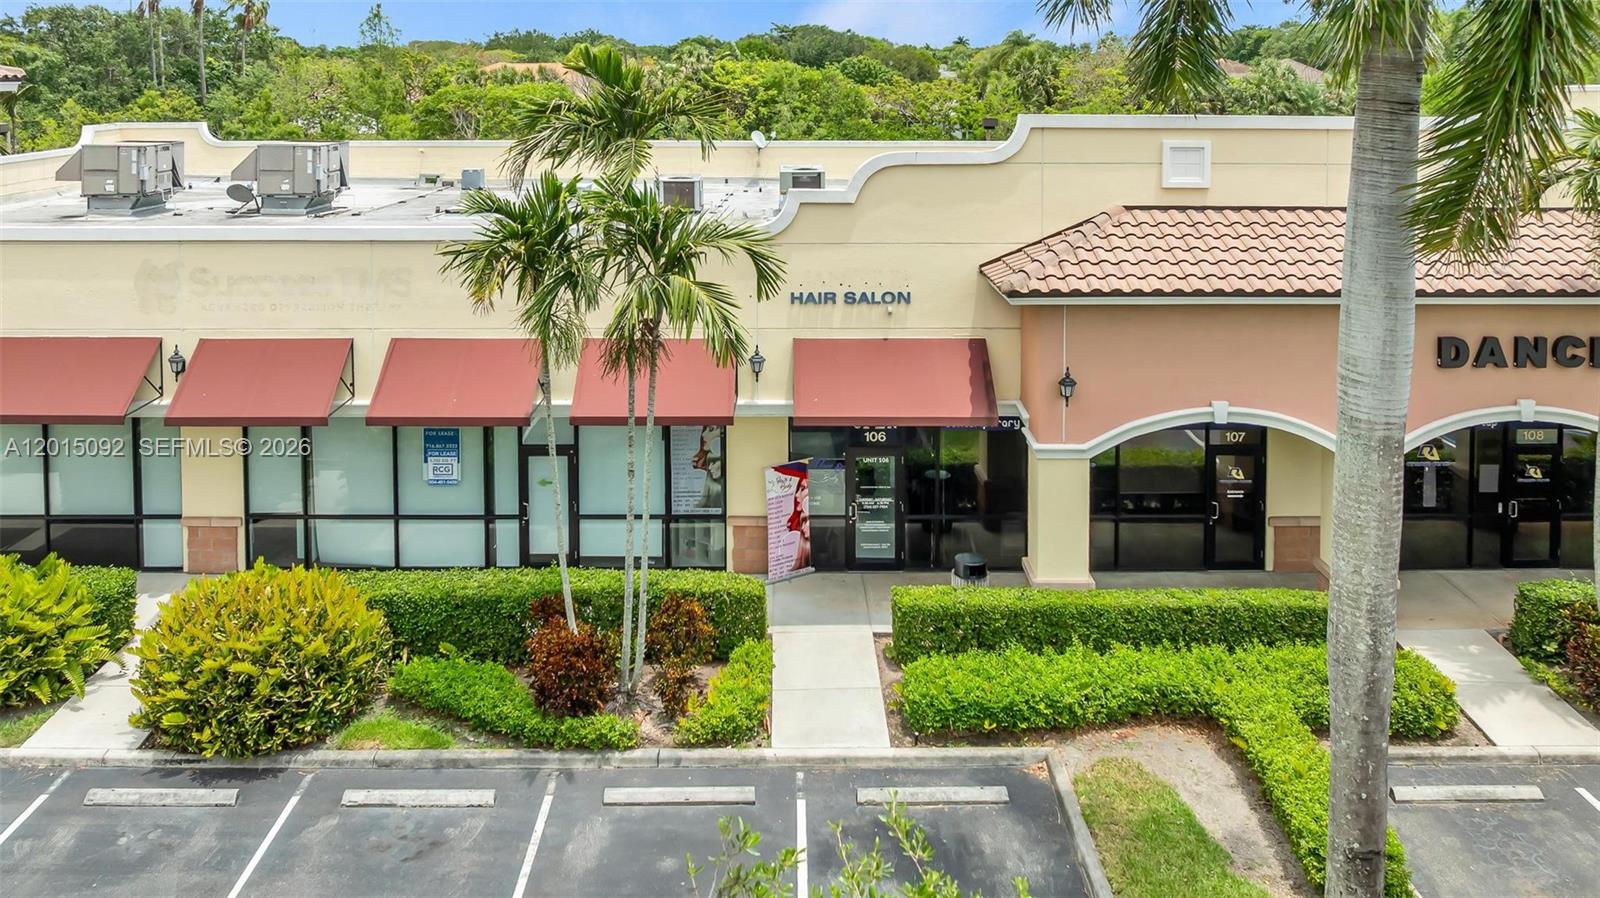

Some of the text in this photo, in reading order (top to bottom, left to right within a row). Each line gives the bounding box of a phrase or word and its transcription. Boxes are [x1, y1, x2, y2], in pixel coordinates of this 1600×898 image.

[789, 291, 911, 305] HAIR SALON
[864, 431, 887, 442] 106
[1225, 431, 1246, 442] 107
[1523, 430, 1544, 441] 108
